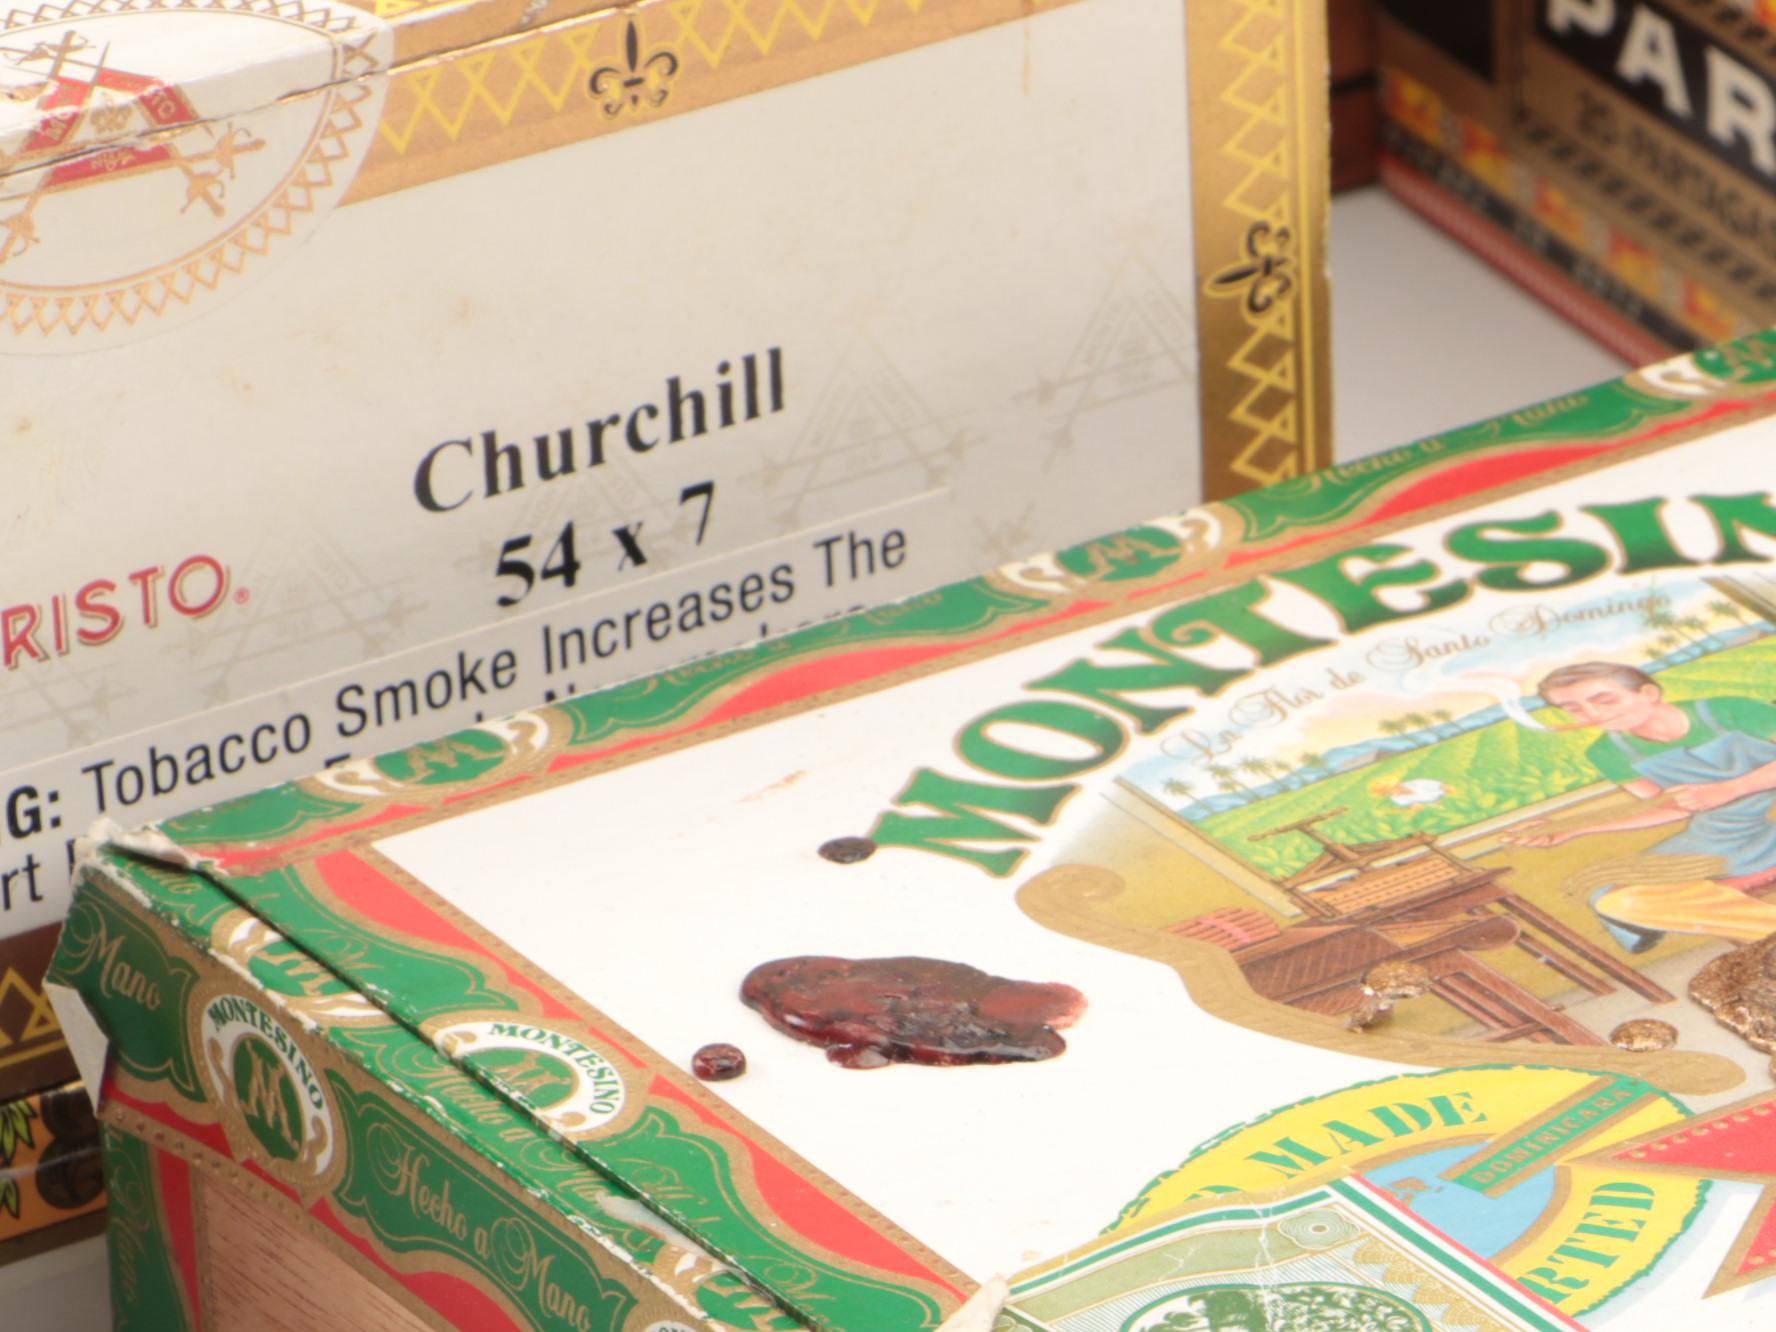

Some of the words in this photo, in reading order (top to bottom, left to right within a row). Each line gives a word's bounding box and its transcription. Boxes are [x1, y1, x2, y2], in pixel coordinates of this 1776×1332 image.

[413, 347, 785, 514] Churchill
[496, 520, 581, 608] 54
[611, 519, 648, 573] x
[678, 481, 717, 546] 7
[81, 712, 312, 814] Tobacco
[334, 640, 518, 737] Smoke
[541, 560, 795, 675] Increases
[813, 528, 907, 588] The
[1328, 665, 1366, 698] de
[1366, 625, 1490, 672] Santo
[1488, 590, 1671, 640] Domingo
[207, 994, 325, 1111] MONTESINO
[490, 1022, 615, 1116] MONTESINO
[366, 1123, 468, 1242] Hecho
[473, 1225, 491, 1257] a
[1245, 1090, 1489, 1180] MADE
